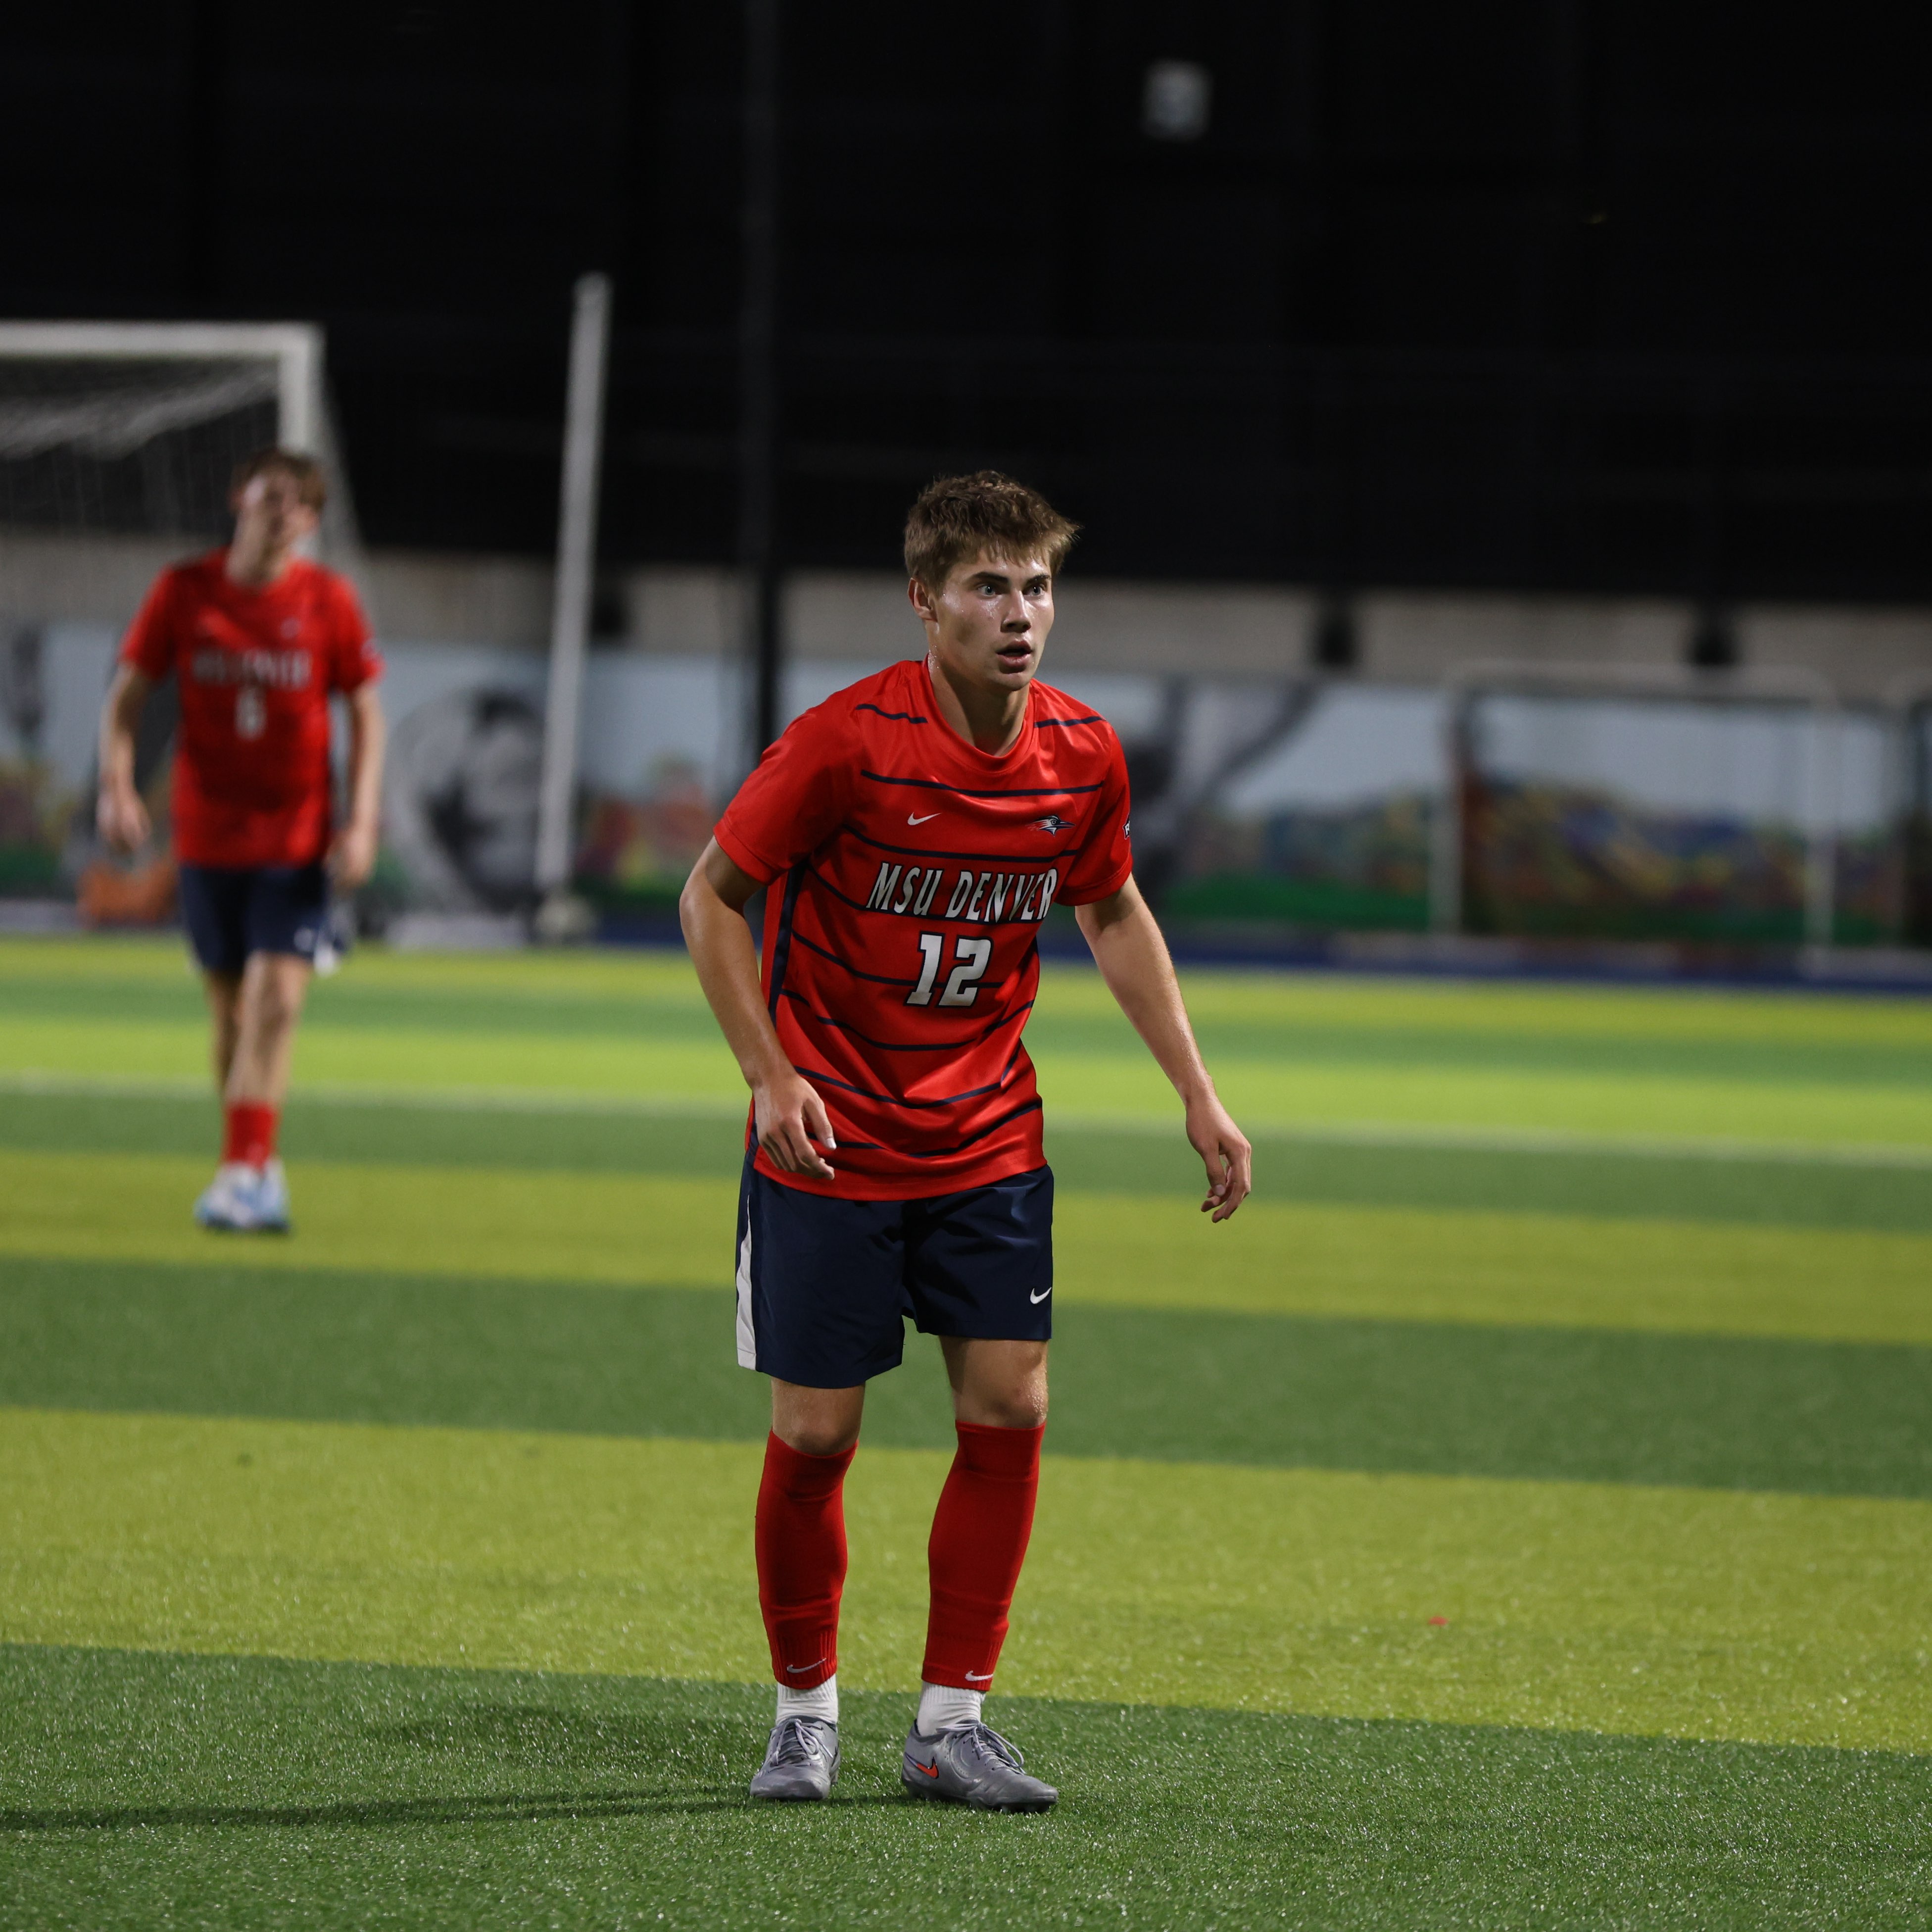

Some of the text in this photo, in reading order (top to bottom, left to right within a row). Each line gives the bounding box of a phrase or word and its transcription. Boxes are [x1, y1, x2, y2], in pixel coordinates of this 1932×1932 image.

[866, 862, 1058, 923] MSU DENVER
[905, 933, 992, 1007] 12
